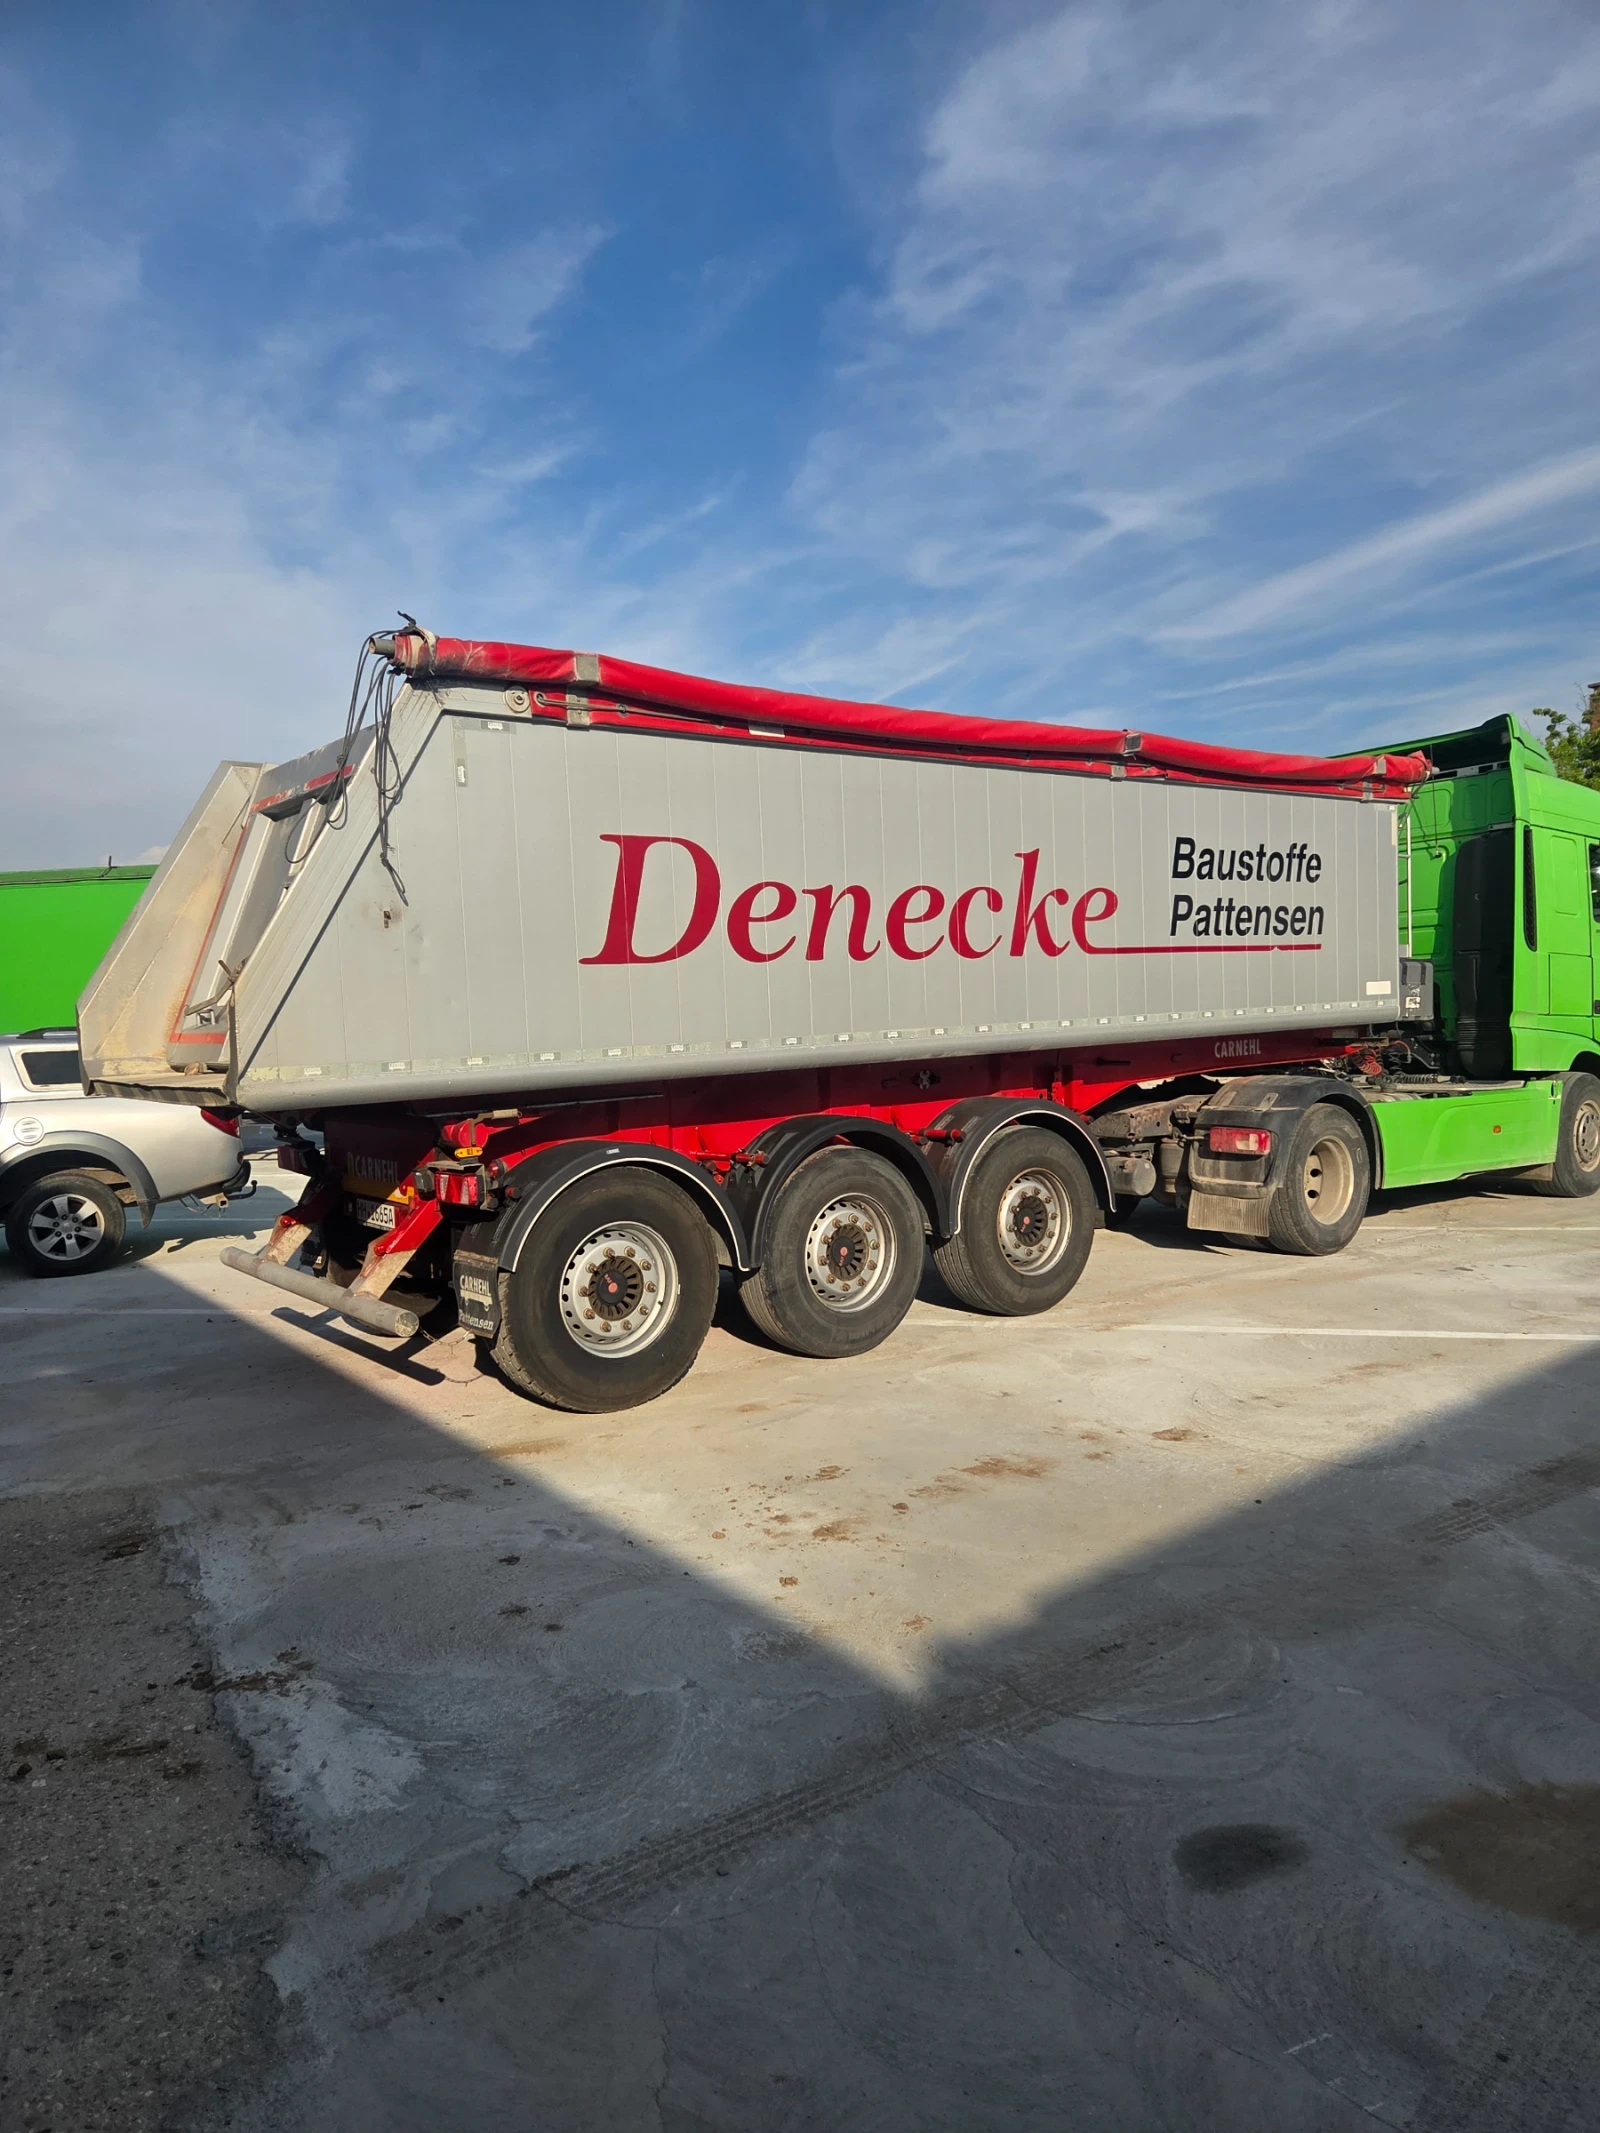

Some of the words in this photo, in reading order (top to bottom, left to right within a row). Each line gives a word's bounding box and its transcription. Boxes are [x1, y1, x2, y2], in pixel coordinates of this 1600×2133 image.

[1172, 836, 1322, 883] Baustoffe
[579, 834, 1119, 965] Denecke
[1170, 894, 1324, 937] Pattensen
[1214, 1039, 1262, 1058] CARNEHL
[355, 1155, 399, 1184] CARNEHL
[459, 1274, 492, 1297] CARNEHL
